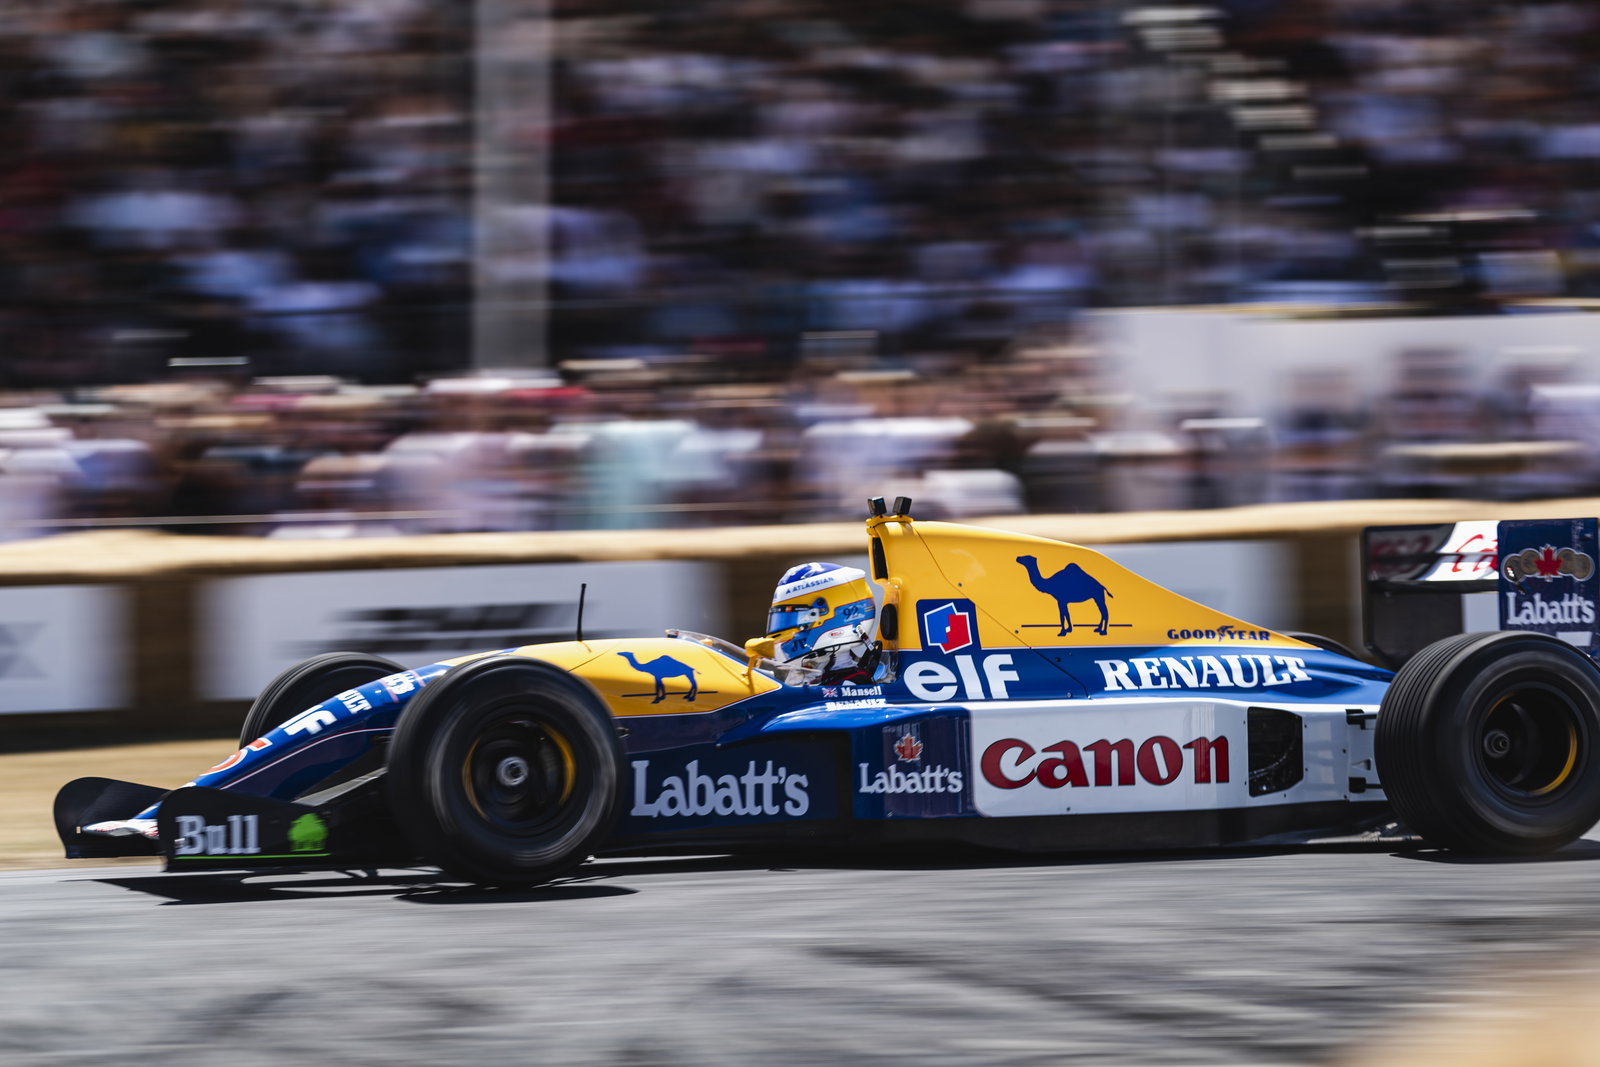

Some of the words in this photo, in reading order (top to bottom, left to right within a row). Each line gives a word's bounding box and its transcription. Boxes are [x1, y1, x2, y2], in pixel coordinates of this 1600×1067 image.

[1507, 592, 1596, 625] Labatt's
[841, 685, 882, 697] Mansell
[903, 653, 1020, 700] elf
[1094, 654, 1313, 691] RENAULT
[630, 759, 809, 818] Labatt's
[859, 762, 963, 794] Labatt's
[175, 814, 262, 856] Bull
